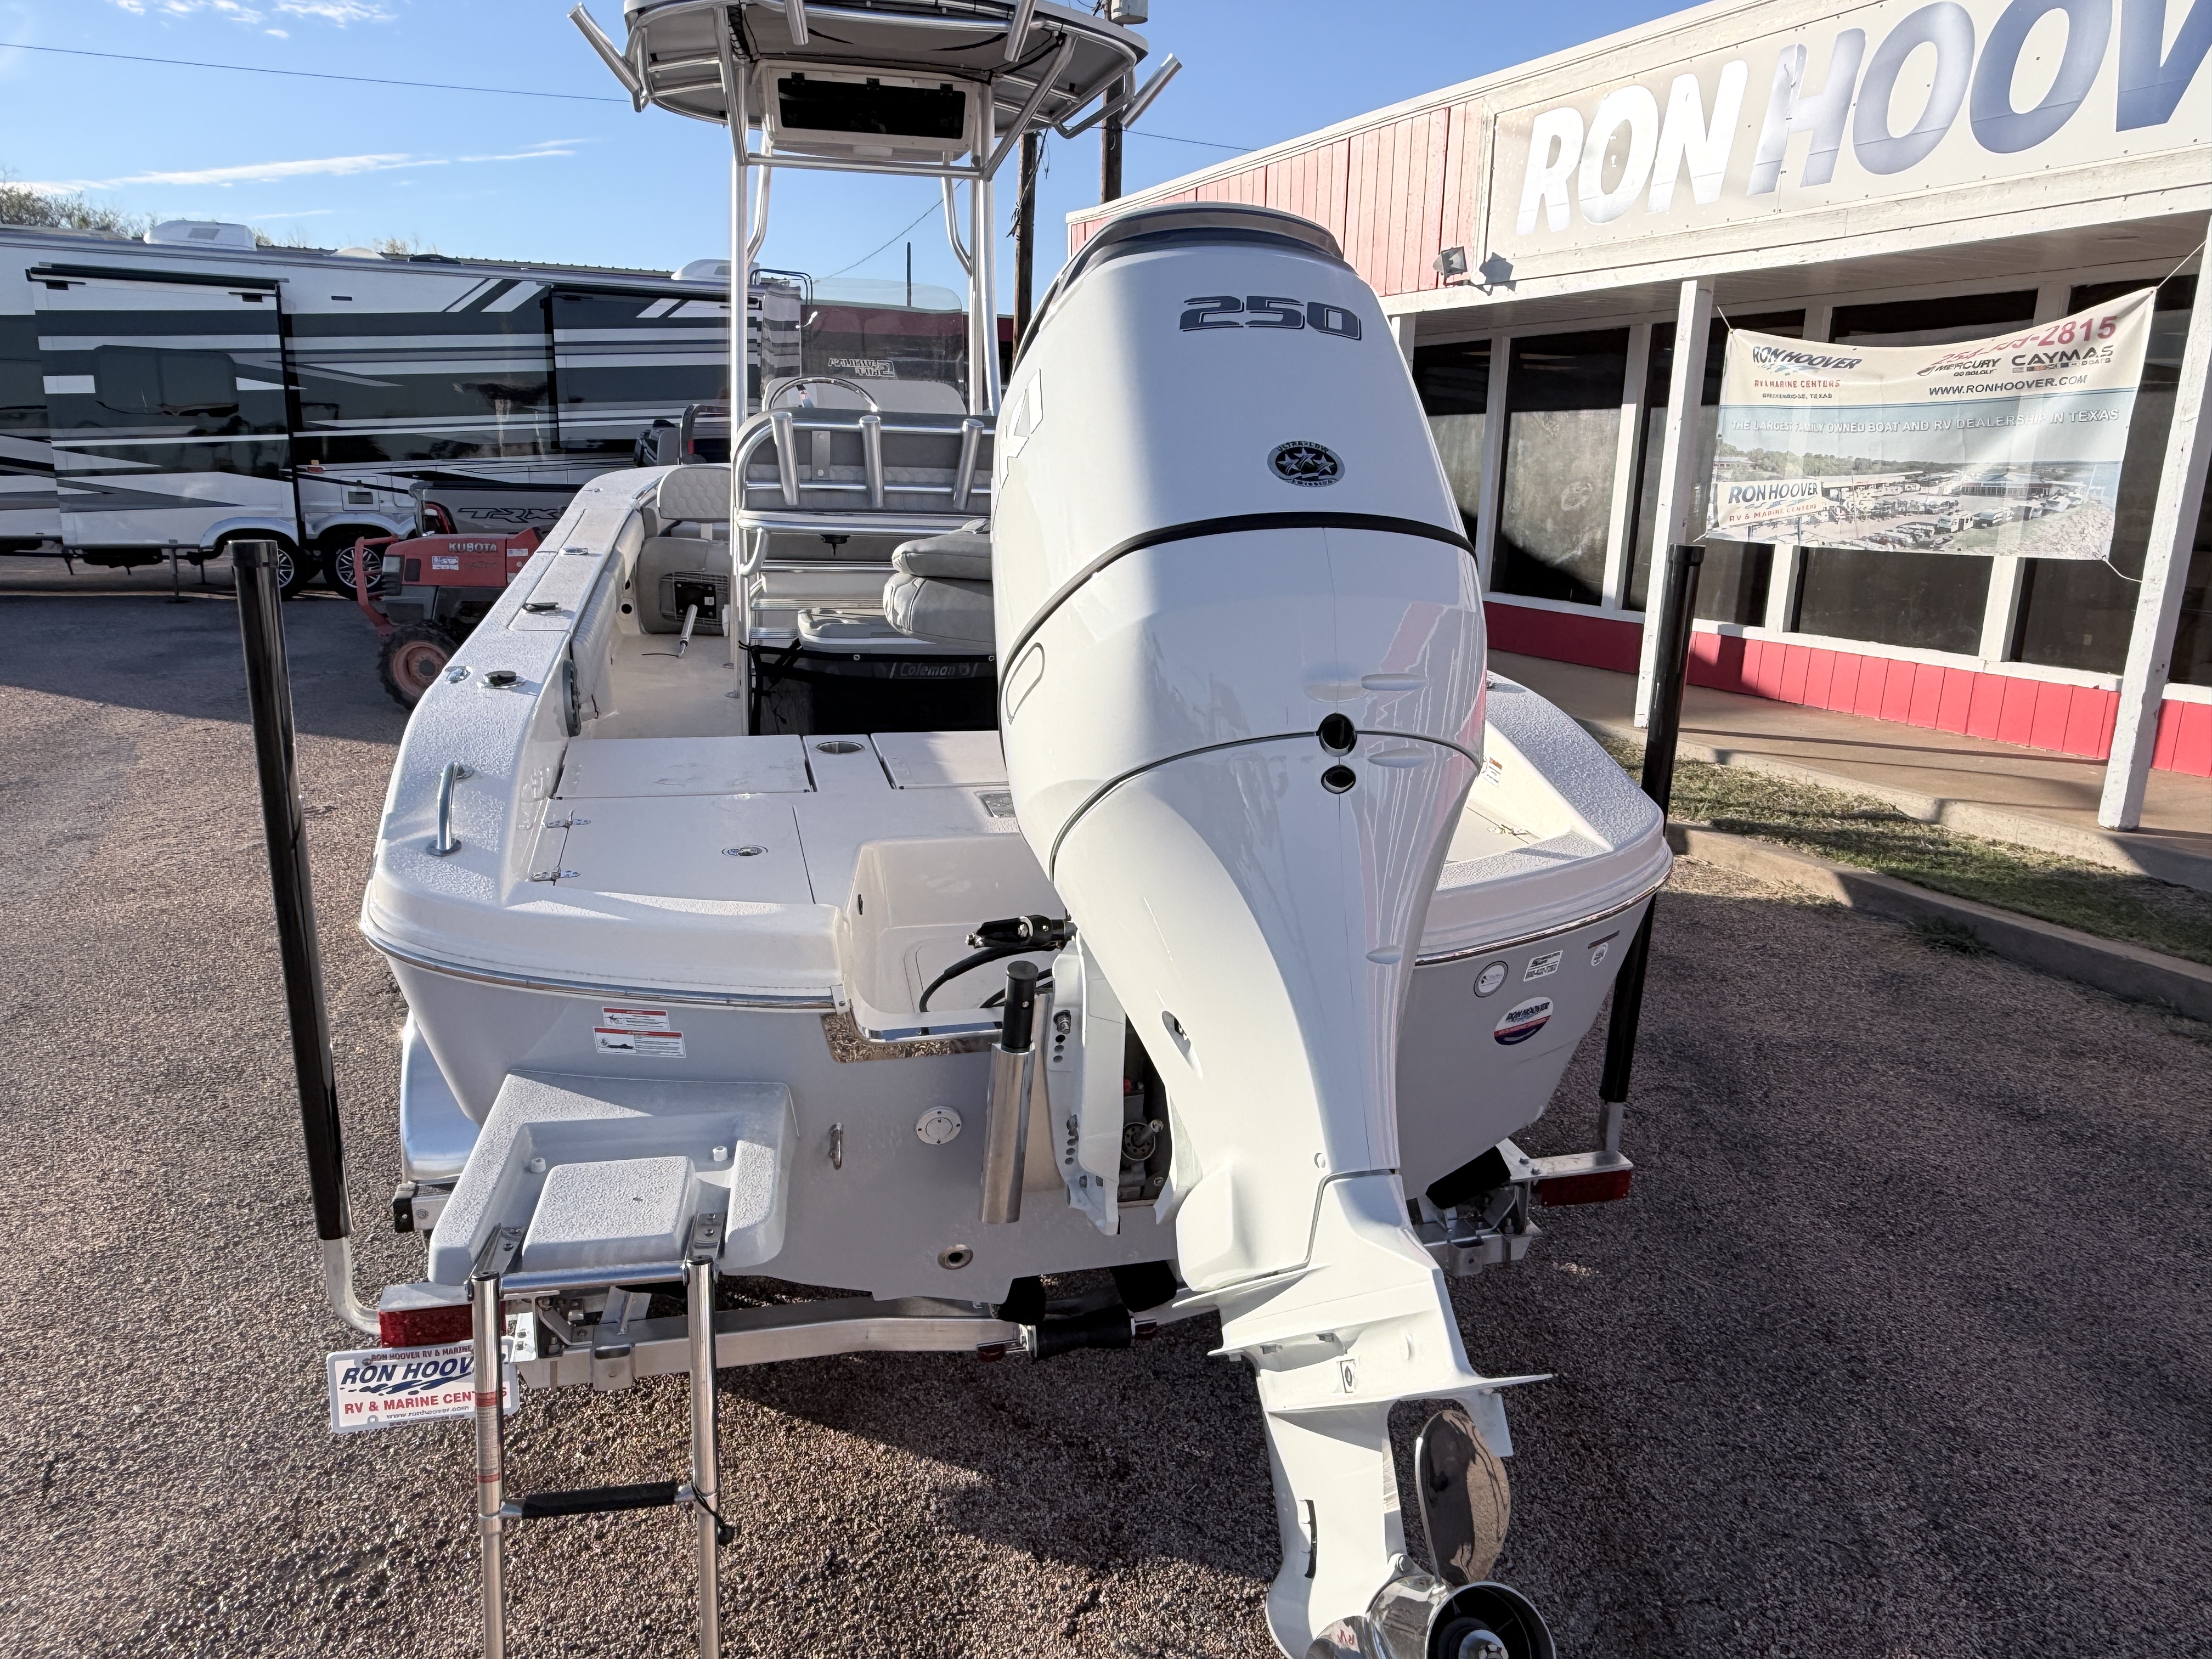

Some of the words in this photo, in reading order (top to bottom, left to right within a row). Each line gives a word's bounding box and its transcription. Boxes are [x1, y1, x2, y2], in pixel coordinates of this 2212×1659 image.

[1516, 59, 1748, 236] RON
[1180, 296, 1361, 341] 250
[1753, 346, 1784, 363] RON
[1783, 351, 1863, 370] HOOVER
[1936, 357, 2002, 372] MERCURY
[2011, 345, 2114, 366] CAYMAS
[1800, 380, 1841, 388] CENTERS
[1929, 375, 2088, 396] WWW.RONHOOVER.COM
[1732, 420, 1751, 431] THE
[1753, 420, 1793, 432] LARGEST
[1827, 421, 1865, 433] OWNED
[1868, 421, 1900, 433] BOAT
[1903, 420, 1929, 432] AND
[1934, 419, 1951, 431] RV
[1955, 413, 2046, 430] DEALERSHIP
[2050, 411, 2064, 424] IN
[2068, 409, 2120, 423] TEXAS
[1728, 484, 1766, 504] RON
[1768, 482, 1818, 500] HOOVER
[457, 507, 559, 523] TRX
[449, 543, 498, 552] KUBOTA
[900, 662, 956, 677] Coleman
[371, 1353, 387, 1362] RON
[390, 1351, 420, 1360] HOOVER
[422, 1350, 432, 1358] RV
[341, 1364, 398, 1386] RON
[402, 1353, 508, 1380] HOOV
[344, 1401, 363, 1414] RV
[369, 1401, 380, 1412] &
[383, 1395, 439, 1410] MARINE
[443, 1386, 507, 1404] CENS
